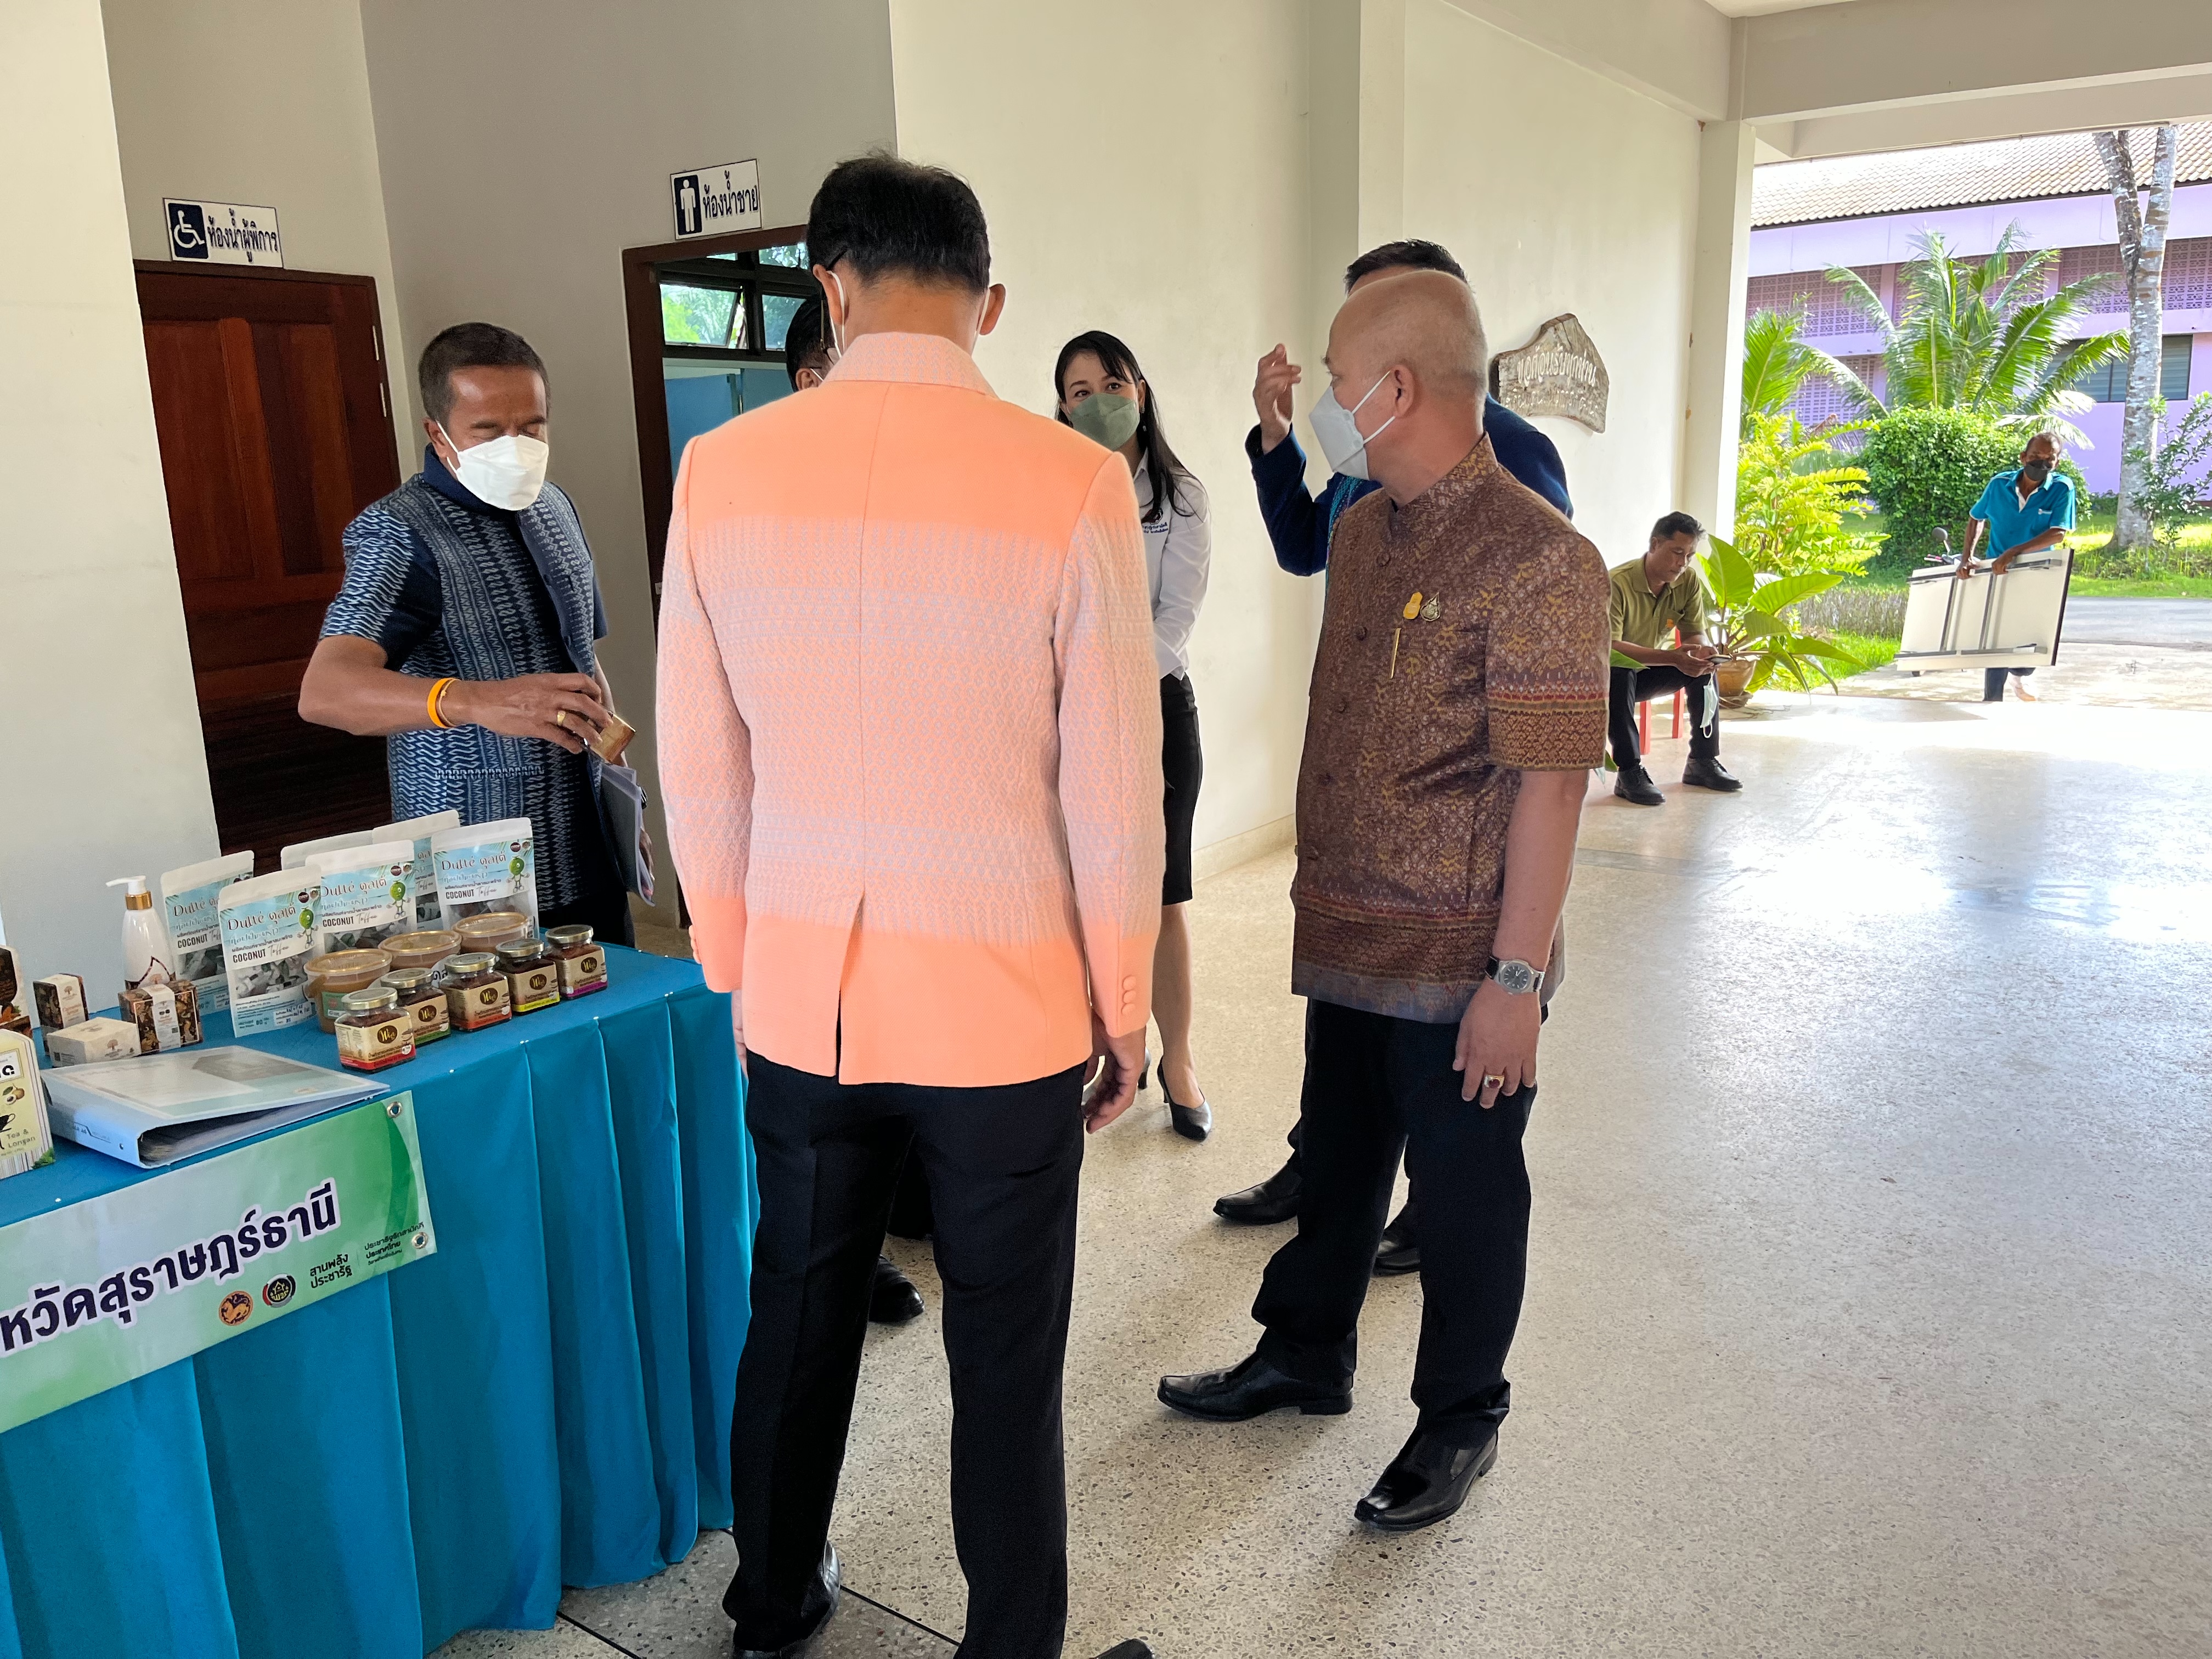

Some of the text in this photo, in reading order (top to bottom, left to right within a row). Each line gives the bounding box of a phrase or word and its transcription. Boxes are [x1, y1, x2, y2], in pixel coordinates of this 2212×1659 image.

[703, 170, 759, 218] ห้องน้ำชาย
[207, 208, 279, 263] ห้องน้ำผู้พิการ
[446, 889, 474, 899] COCONUT
[323, 916, 354, 927] COCONUT
[178, 934, 208, 949] COCONUT
[233, 949, 266, 963] COCONUT
[8, 1136, 36, 1148] Longan
[366, 1241, 401, 1259] ประเทศไทย
[310, 1254, 348, 1277] สานพลัง
[311, 1266, 353, 1289] ประชารัฐ
